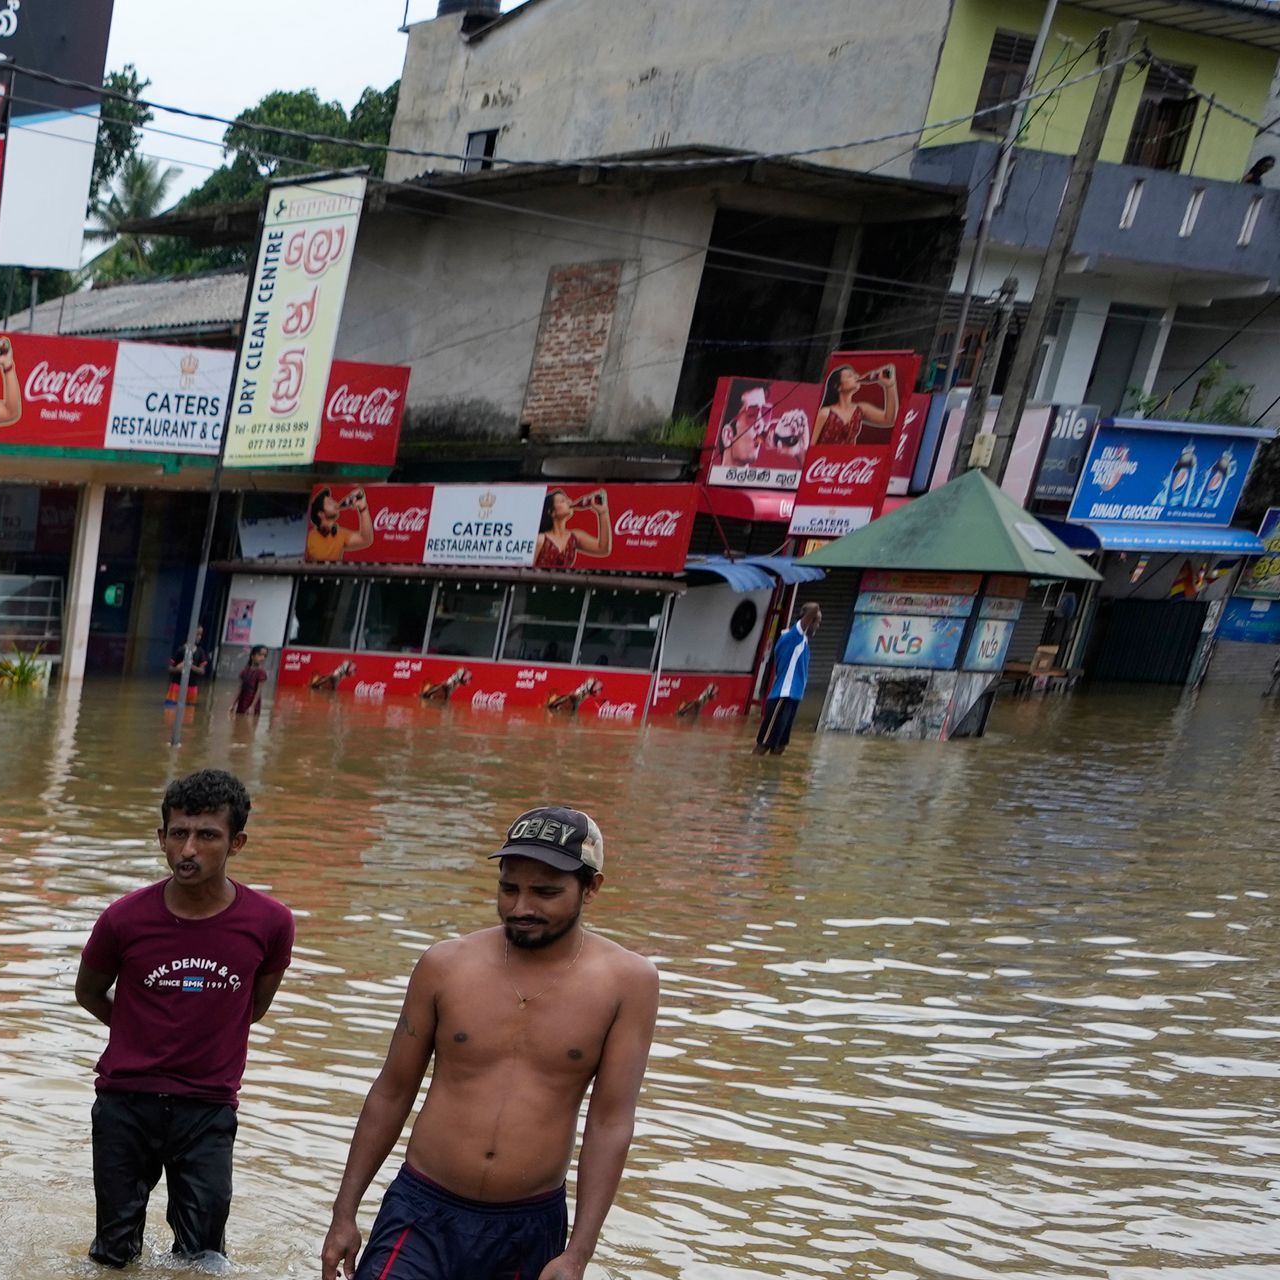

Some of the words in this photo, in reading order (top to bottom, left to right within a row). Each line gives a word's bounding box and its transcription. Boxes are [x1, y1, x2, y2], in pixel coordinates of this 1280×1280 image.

[257, 230, 285, 303] CENTRE
[245, 311, 271, 370] CLEAN
[145, 392, 220, 416] CATERS
[237, 379, 258, 415] DRY
[40, 408, 58, 420] Real
[58, 409, 81, 422] Magic
[111, 416, 197, 440] RESTAURANT
[199, 424, 208, 440] &
[251, 424, 266, 434] 077
[268, 424, 274, 434] 4
[275, 423, 290, 434] 963
[248, 439, 263, 450] 077
[1101, 446, 1130, 460] ENJOY
[1121, 504, 1164, 520] GROCERY
[452, 522, 513, 537] CATERS
[810, 518, 850, 527] CATERS
[427, 538, 493, 552] RESTAURANT
[495, 540, 502, 552] &
[505, 540, 534, 554] CAFE
[509, 817, 577, 847] OBEY
[143, 964, 170, 988] SMK
[171, 957, 218, 972] DENIM
[217, 966, 228, 978] &
[158, 979, 181, 987] SINCE
[182, 980, 203, 988] SMK
[206, 981, 227, 989] 1991
